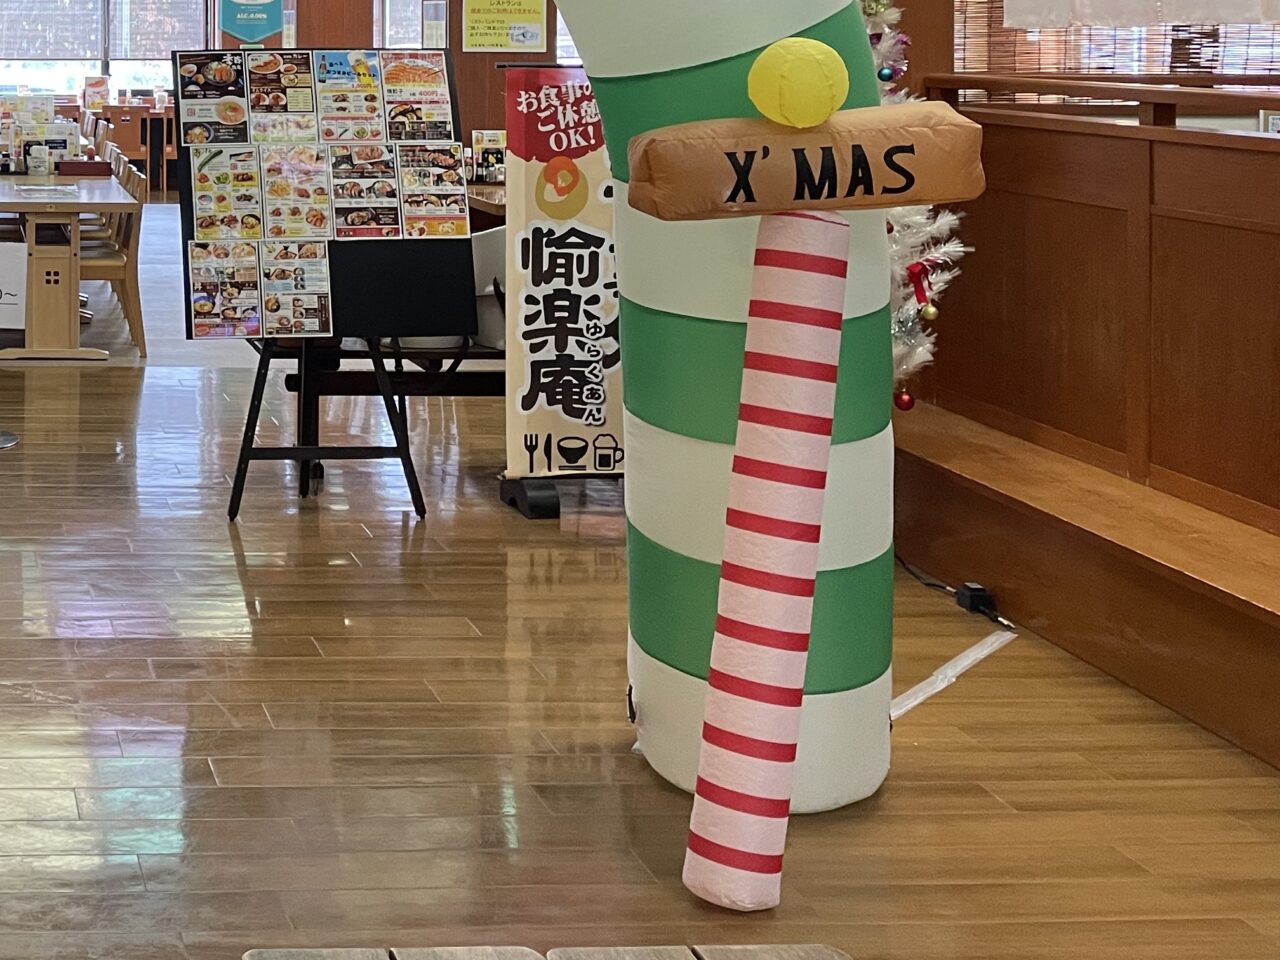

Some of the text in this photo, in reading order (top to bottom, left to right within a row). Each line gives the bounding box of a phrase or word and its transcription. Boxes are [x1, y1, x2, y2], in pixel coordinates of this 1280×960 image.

[537, 101, 601, 132] ご休憩
[549, 125, 596, 152] OK!
[521, 227, 606, 420] 愉楽庵
[584, 321, 606, 426] ゆらくあん
